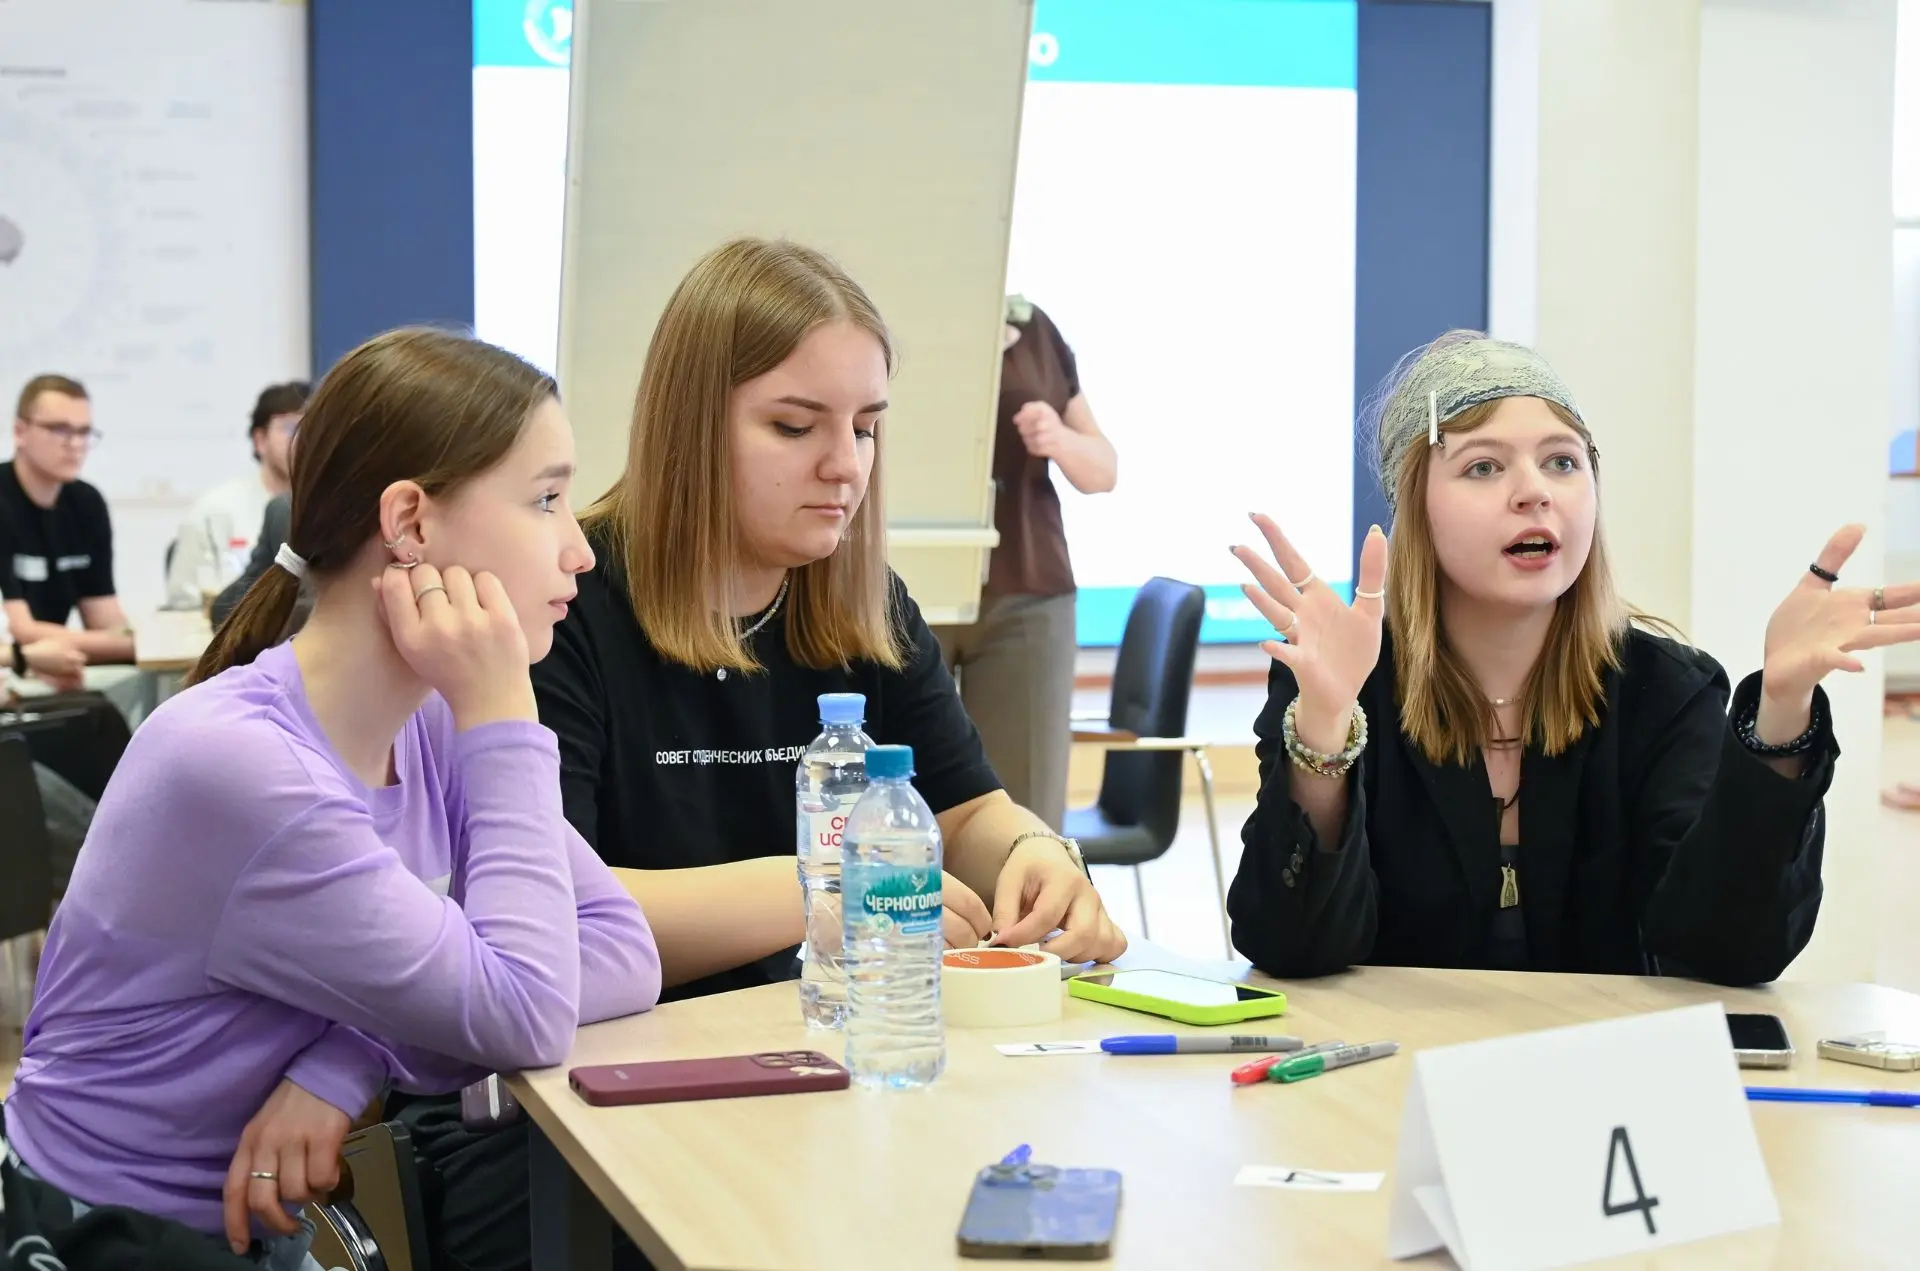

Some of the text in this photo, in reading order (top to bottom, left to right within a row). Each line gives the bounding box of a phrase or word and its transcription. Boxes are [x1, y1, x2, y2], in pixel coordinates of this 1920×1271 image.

[655, 750, 692, 764] СОВЕТ
[692, 749, 763, 765] СТДЕНЧЕСКИХ
[1602, 1126, 1660, 1235] 4
